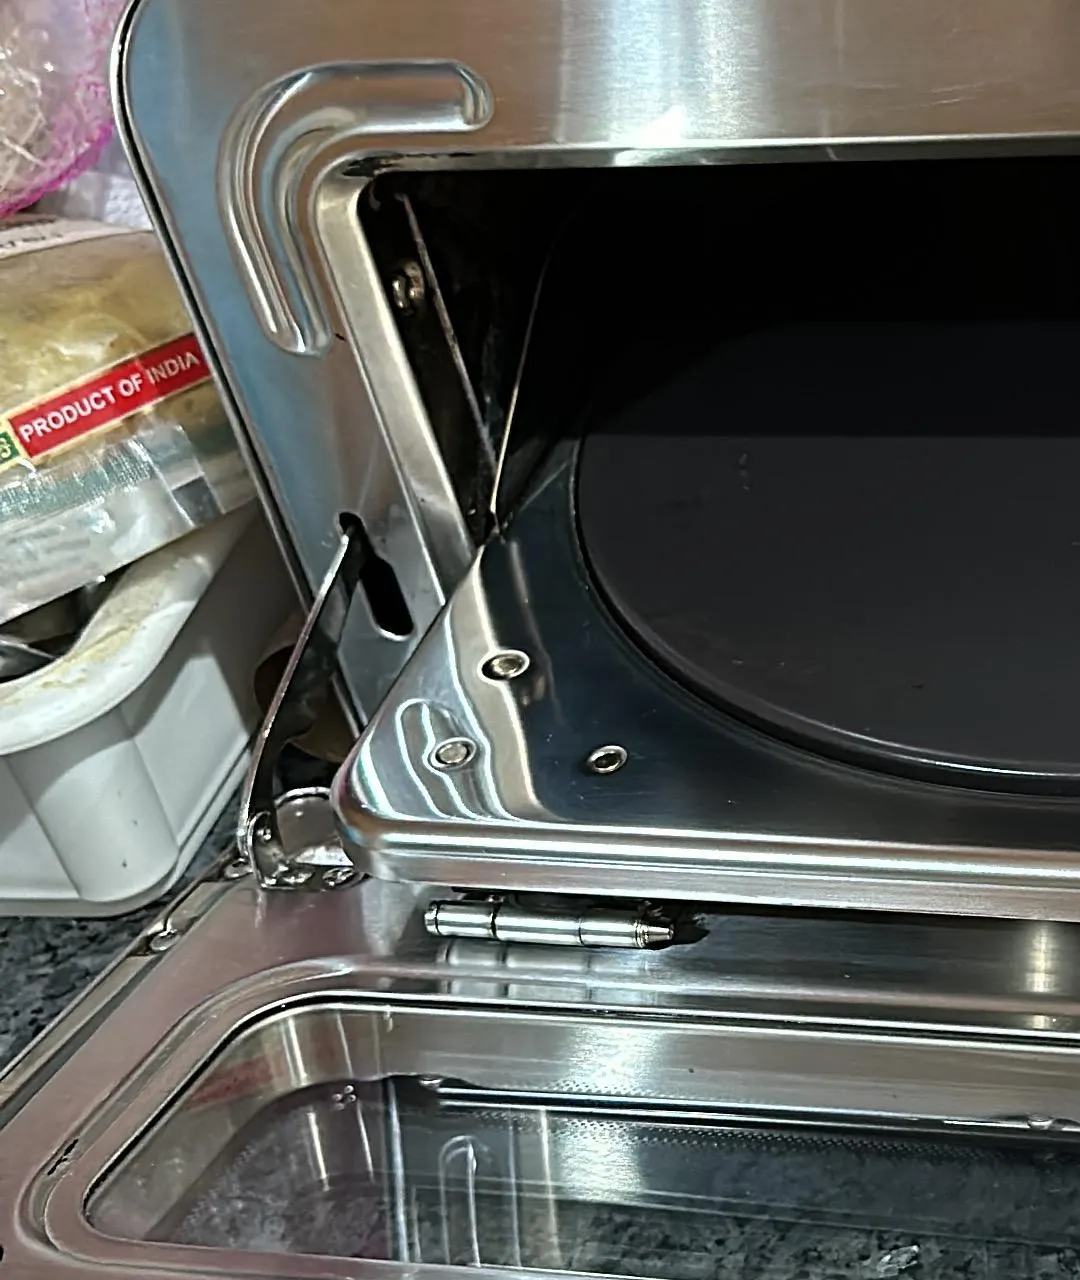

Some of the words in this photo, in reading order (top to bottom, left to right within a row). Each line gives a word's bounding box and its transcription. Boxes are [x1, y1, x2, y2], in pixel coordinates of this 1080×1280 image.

[19, 386, 117, 442] PRODUCT
[118, 373, 144, 397] OF
[145, 351, 199, 384] INDIA
